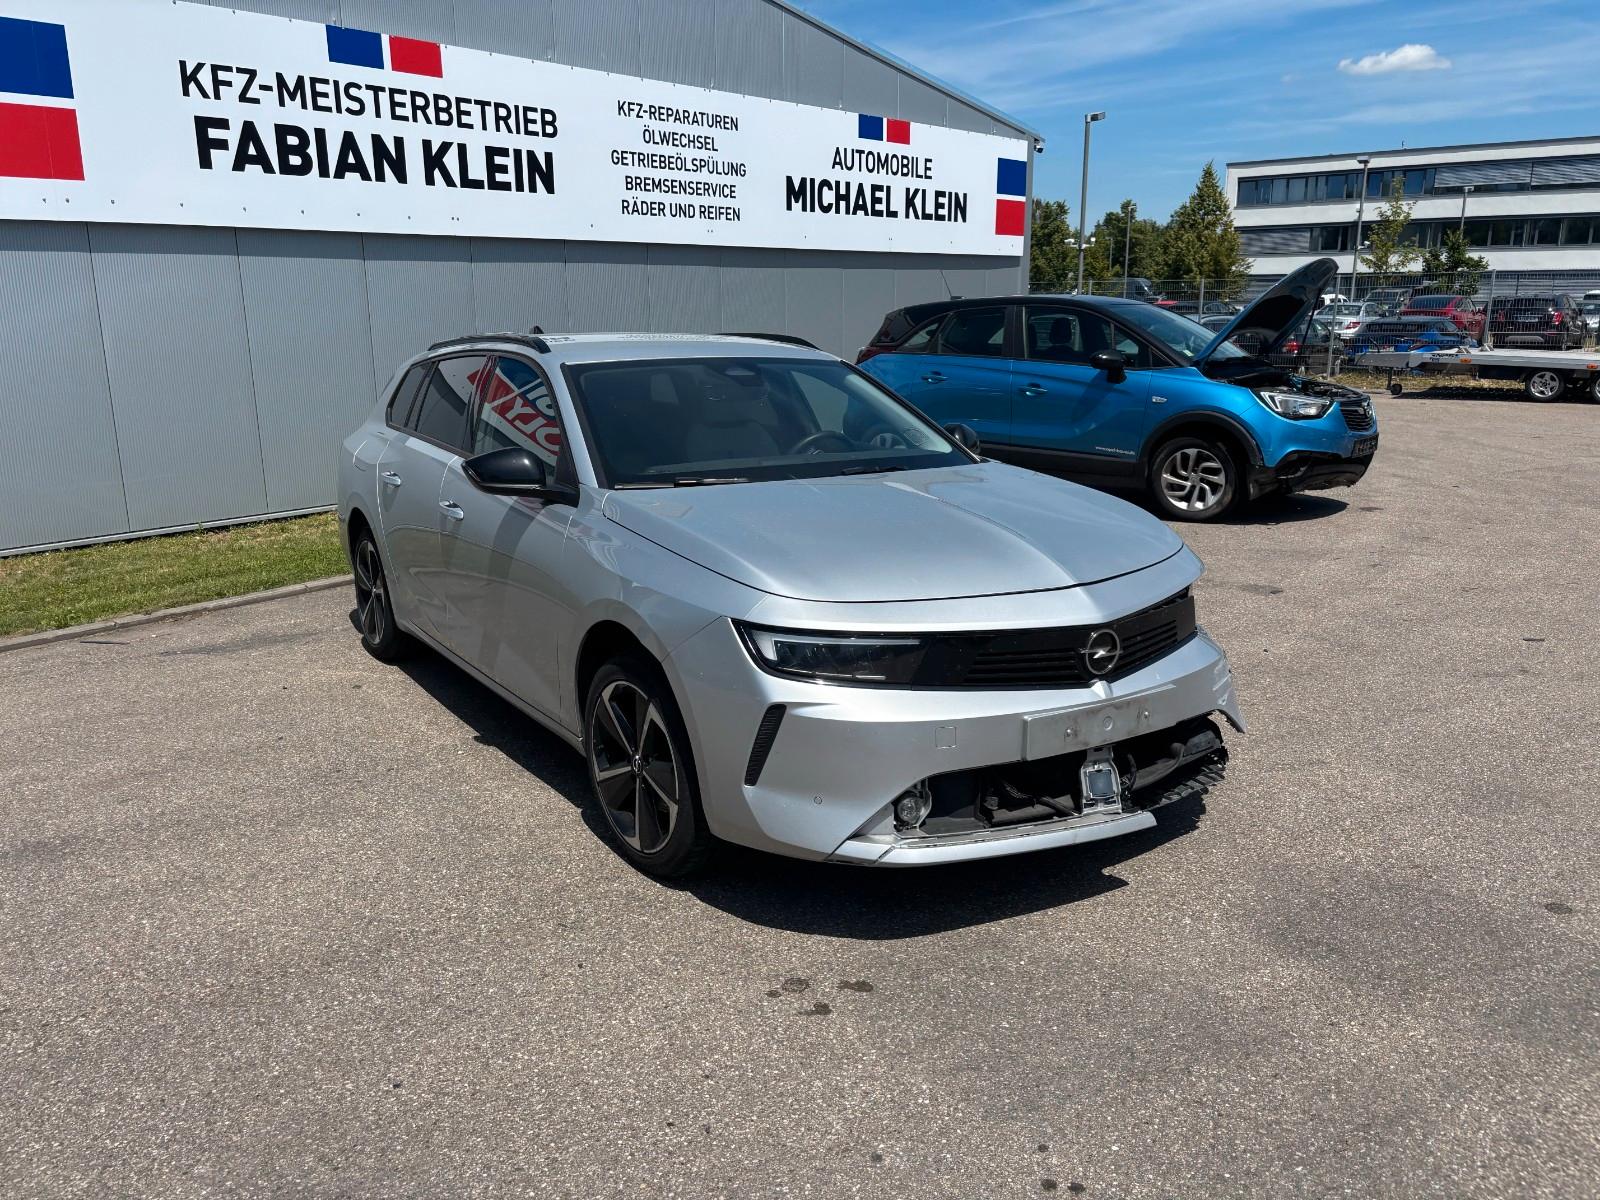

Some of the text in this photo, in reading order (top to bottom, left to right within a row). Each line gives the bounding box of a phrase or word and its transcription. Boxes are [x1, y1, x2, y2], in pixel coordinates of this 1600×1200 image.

[179, 60, 558, 139] KFZ-MEISTERBETRIEB
[617, 99, 739, 132] KFZ-REPARATUREN
[642, 124, 719, 152] ÖLWECHSEL
[193, 115, 556, 195] FABIAN KLEIN
[610, 149, 747, 178] GETRIEBEÖLSPÜLUNG
[831, 146, 933, 180] AUTOMOBILE
[624, 175, 737, 199] BREMSENSERVICE
[785, 175, 968, 223] MICHAEL KLEIN
[621, 196, 741, 222] RÄDER UND REIFEN
